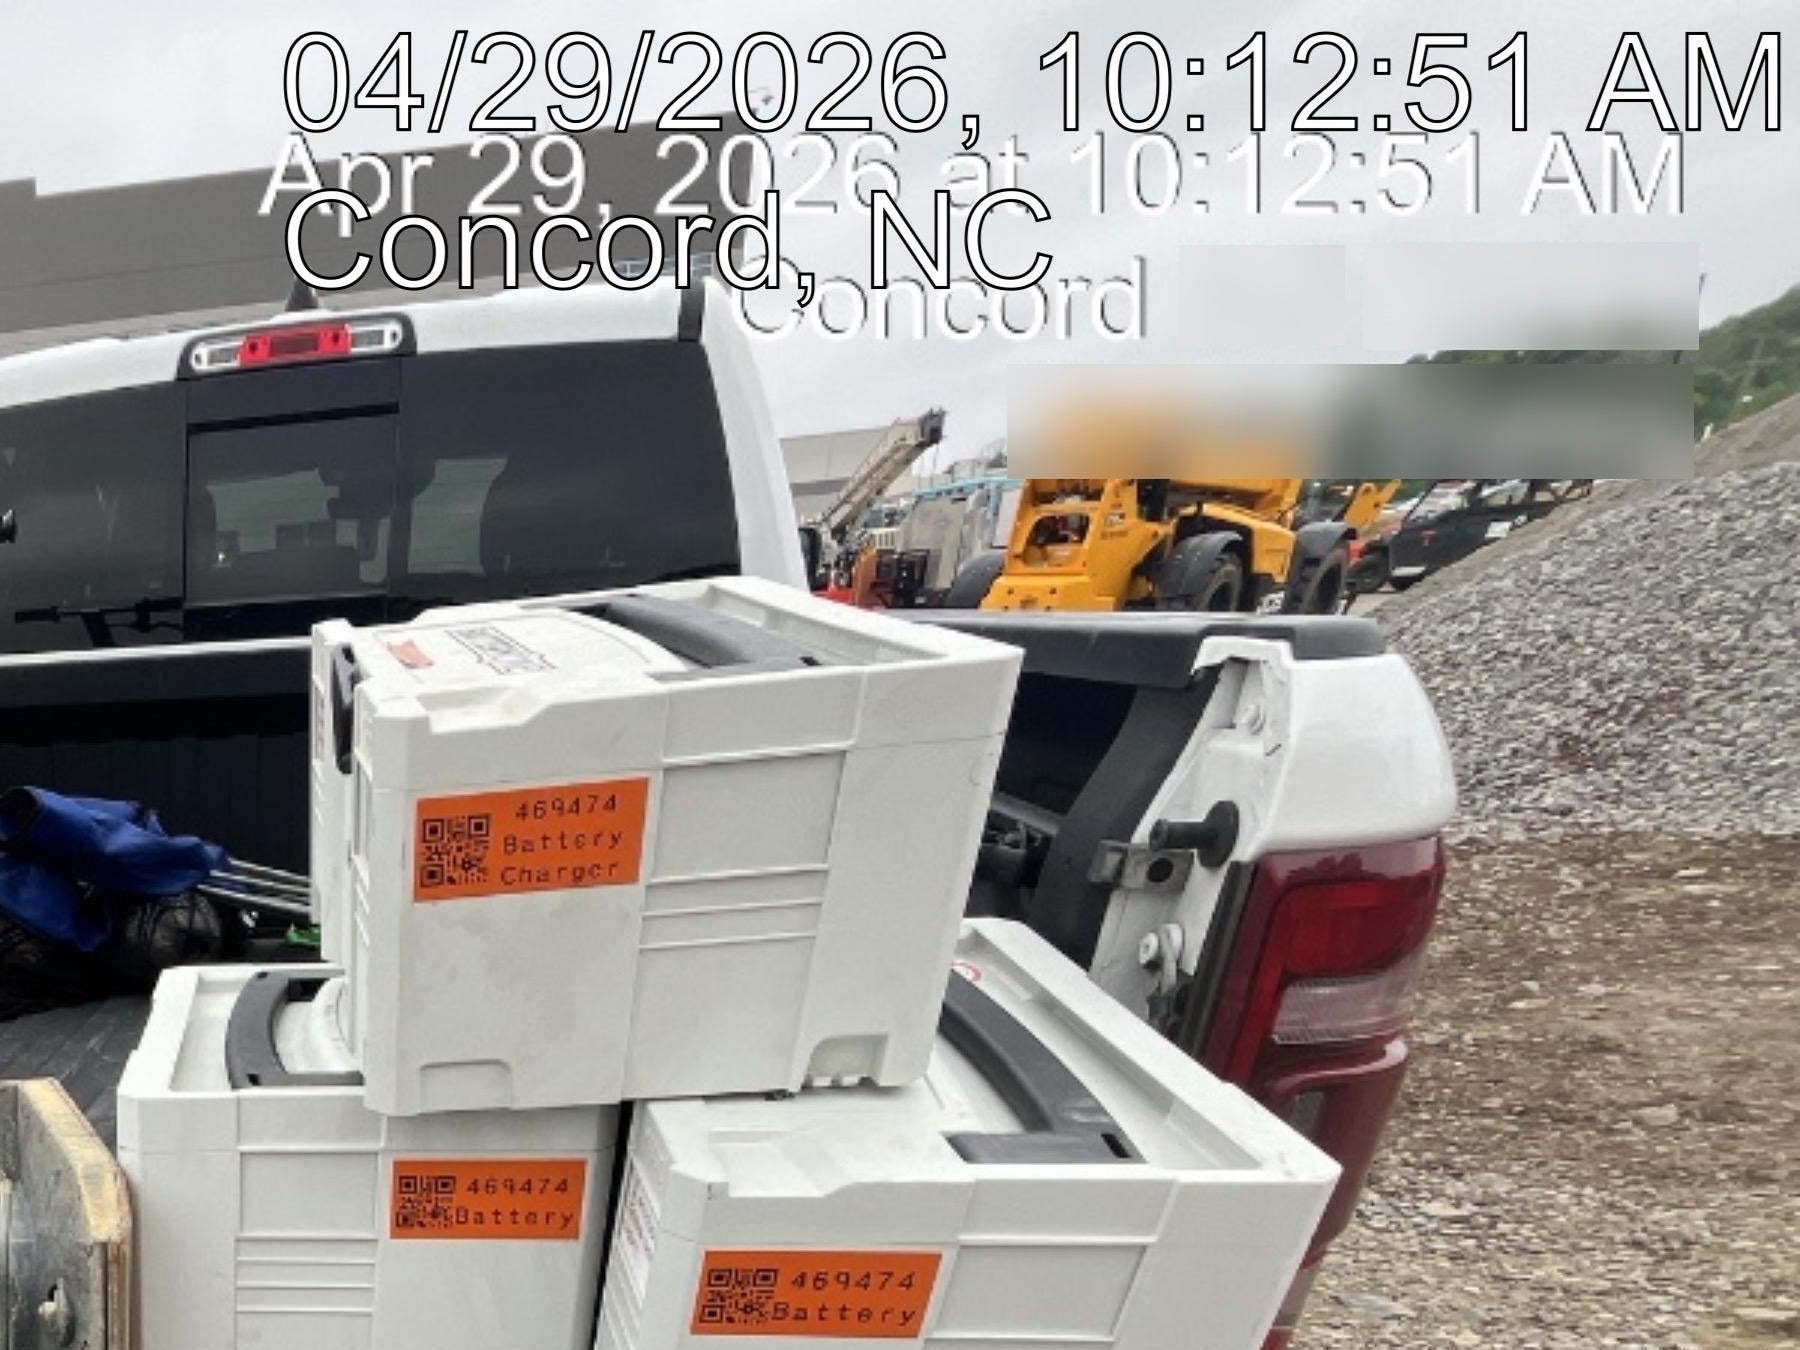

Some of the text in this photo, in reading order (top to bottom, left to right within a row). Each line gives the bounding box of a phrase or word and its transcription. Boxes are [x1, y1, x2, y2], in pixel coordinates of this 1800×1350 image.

[515, 793, 618, 821] 469474
[503, 831, 623, 856] Battery
[500, 861, 620, 886] Charger
[466, 1177, 569, 1195] 469474
[455, 1206, 574, 1230] Battery
[790, 1271, 917, 1291] 469474
[770, 1302, 917, 1327] Battery
